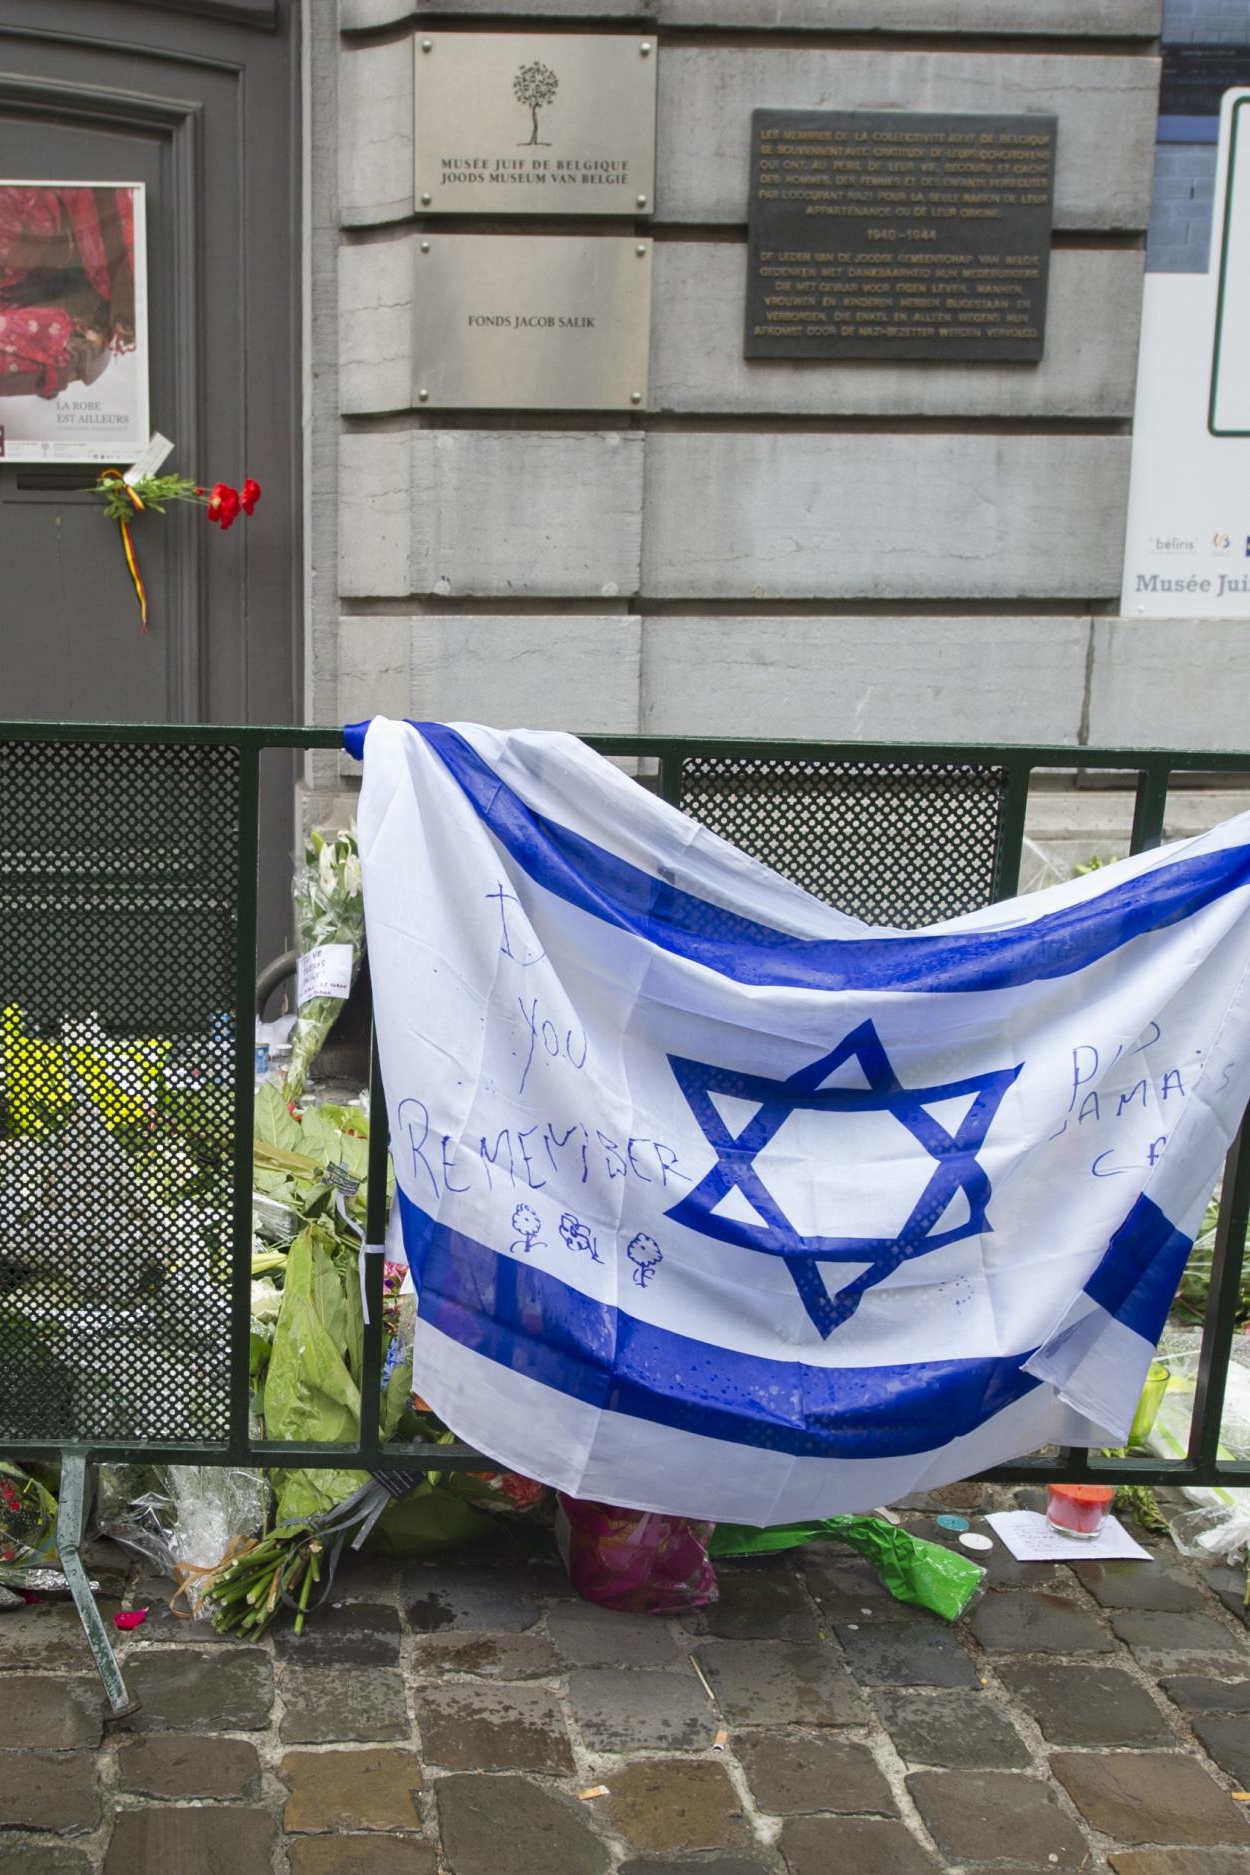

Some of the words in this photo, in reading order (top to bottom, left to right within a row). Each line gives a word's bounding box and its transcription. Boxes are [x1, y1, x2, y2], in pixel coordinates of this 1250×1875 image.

[441, 158, 489, 170] MUSÉE
[494, 160, 526, 171] JUIF
[532, 160, 550, 170] DE
[557, 161, 629, 172] BELGIQUE
[440, 173, 485, 185] JOODS
[489, 173, 546, 183] MUSEUM
[551, 174, 576, 184] VAN
[468, 316, 511, 326] FONDS
[515, 316, 555, 329] JACOB
[559, 317, 595, 328] SALIK
[56, 401, 70, 410] LA
[73, 402, 101, 410] ROBE
[57, 415, 75, 423] EST
[79, 415, 129, 424] AILLEURS
[1135, 574, 1211, 592] Musée
[1216, 574, 1250, 597] Jui
[518, 997, 588, 1095] YOU
[398, 1098, 693, 1199] REMEMBER
